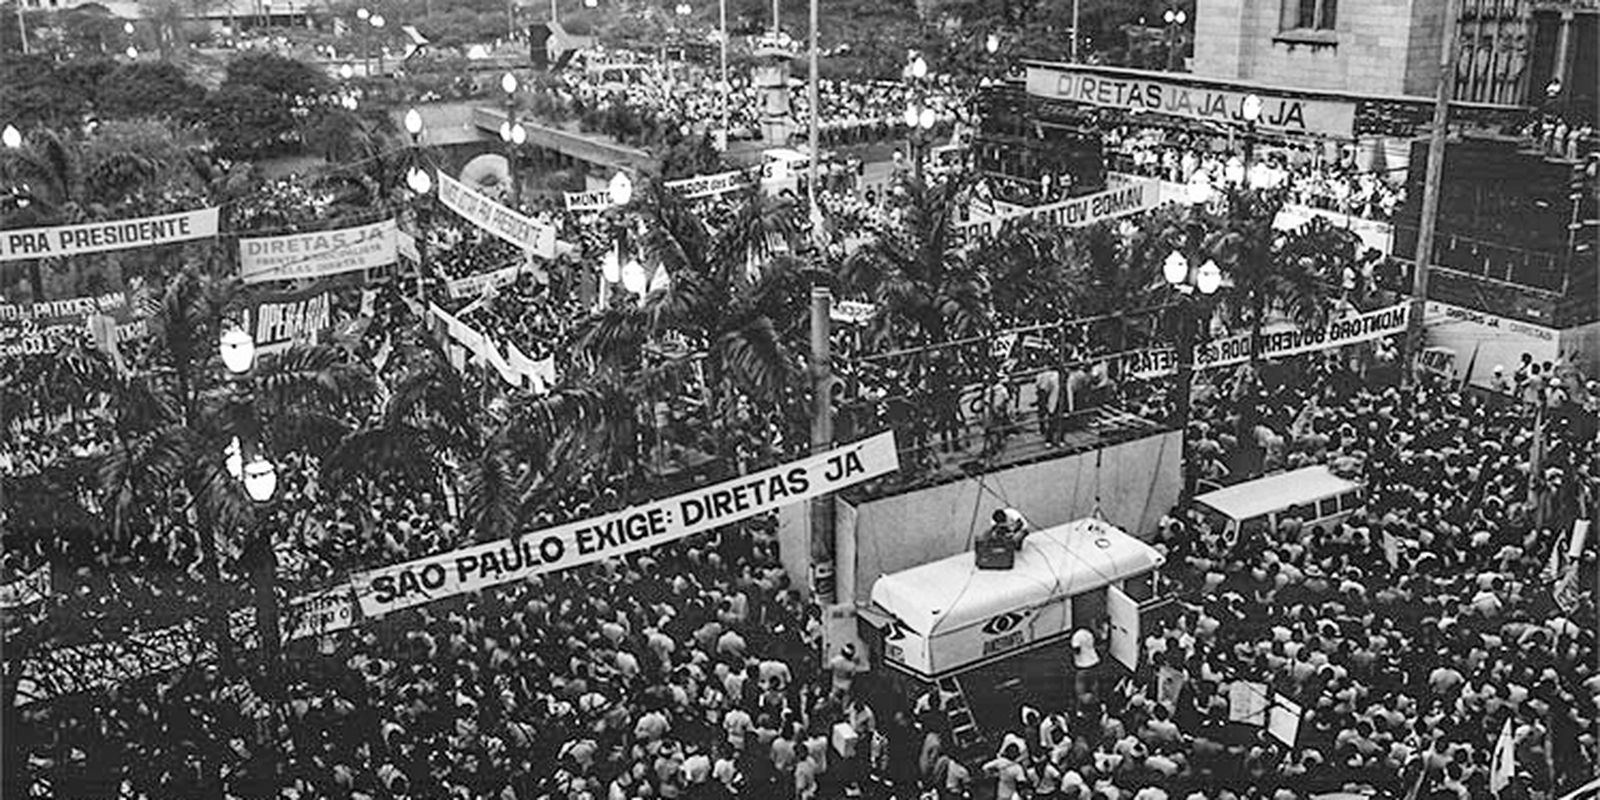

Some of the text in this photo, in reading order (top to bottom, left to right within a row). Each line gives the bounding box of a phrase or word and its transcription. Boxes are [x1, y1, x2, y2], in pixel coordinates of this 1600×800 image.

[1057, 74, 1162, 110] DIRETAS
[8, 216, 191, 255] PRA PRESIDENTE
[248, 231, 347, 256] DIRETAS
[455, 536, 565, 583] PAULO
[574, 507, 673, 556] EXIGE:
[680, 467, 810, 528] DIRETAS
[824, 444, 866, 482] JÁ
